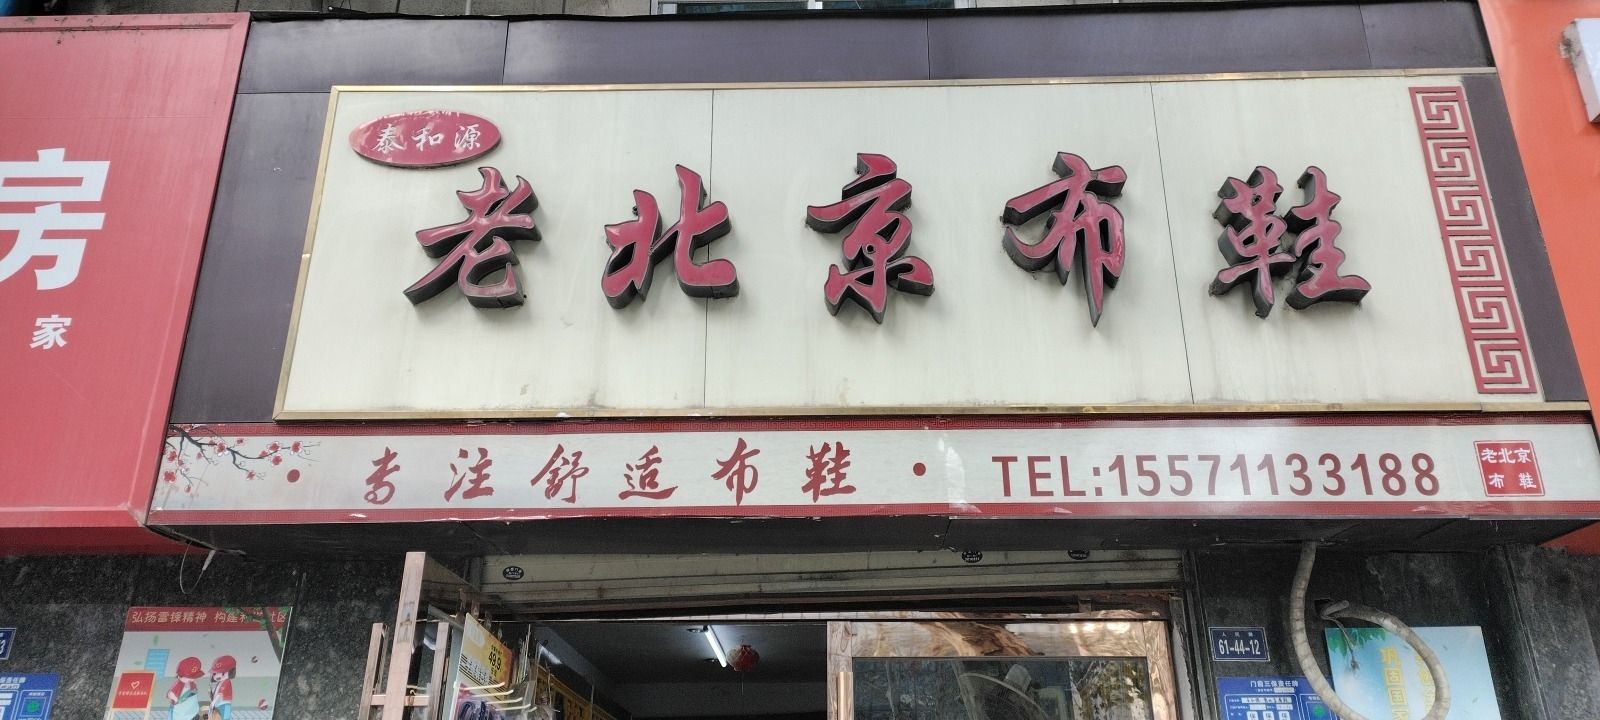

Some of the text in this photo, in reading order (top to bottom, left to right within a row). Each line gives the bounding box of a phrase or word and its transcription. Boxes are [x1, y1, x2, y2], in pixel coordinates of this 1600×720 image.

[372, 123, 482, 154] 泰和源
[0, 147, 110, 290] 房
[403, 152, 1371, 327] 老北京布鞋
[29, 314, 72, 350] 家
[364, 438, 857, 506] 专注舒适布鞋
[1481, 447, 1532, 464] 老北京
[992, 452, 1441, 497] TEL:15571133188
[1488, 472, 1537, 489] 布鞋
[131, 611, 207, 623] 弘扬雷锋精神
[1218, 639, 1261, 655] 61-44-12
